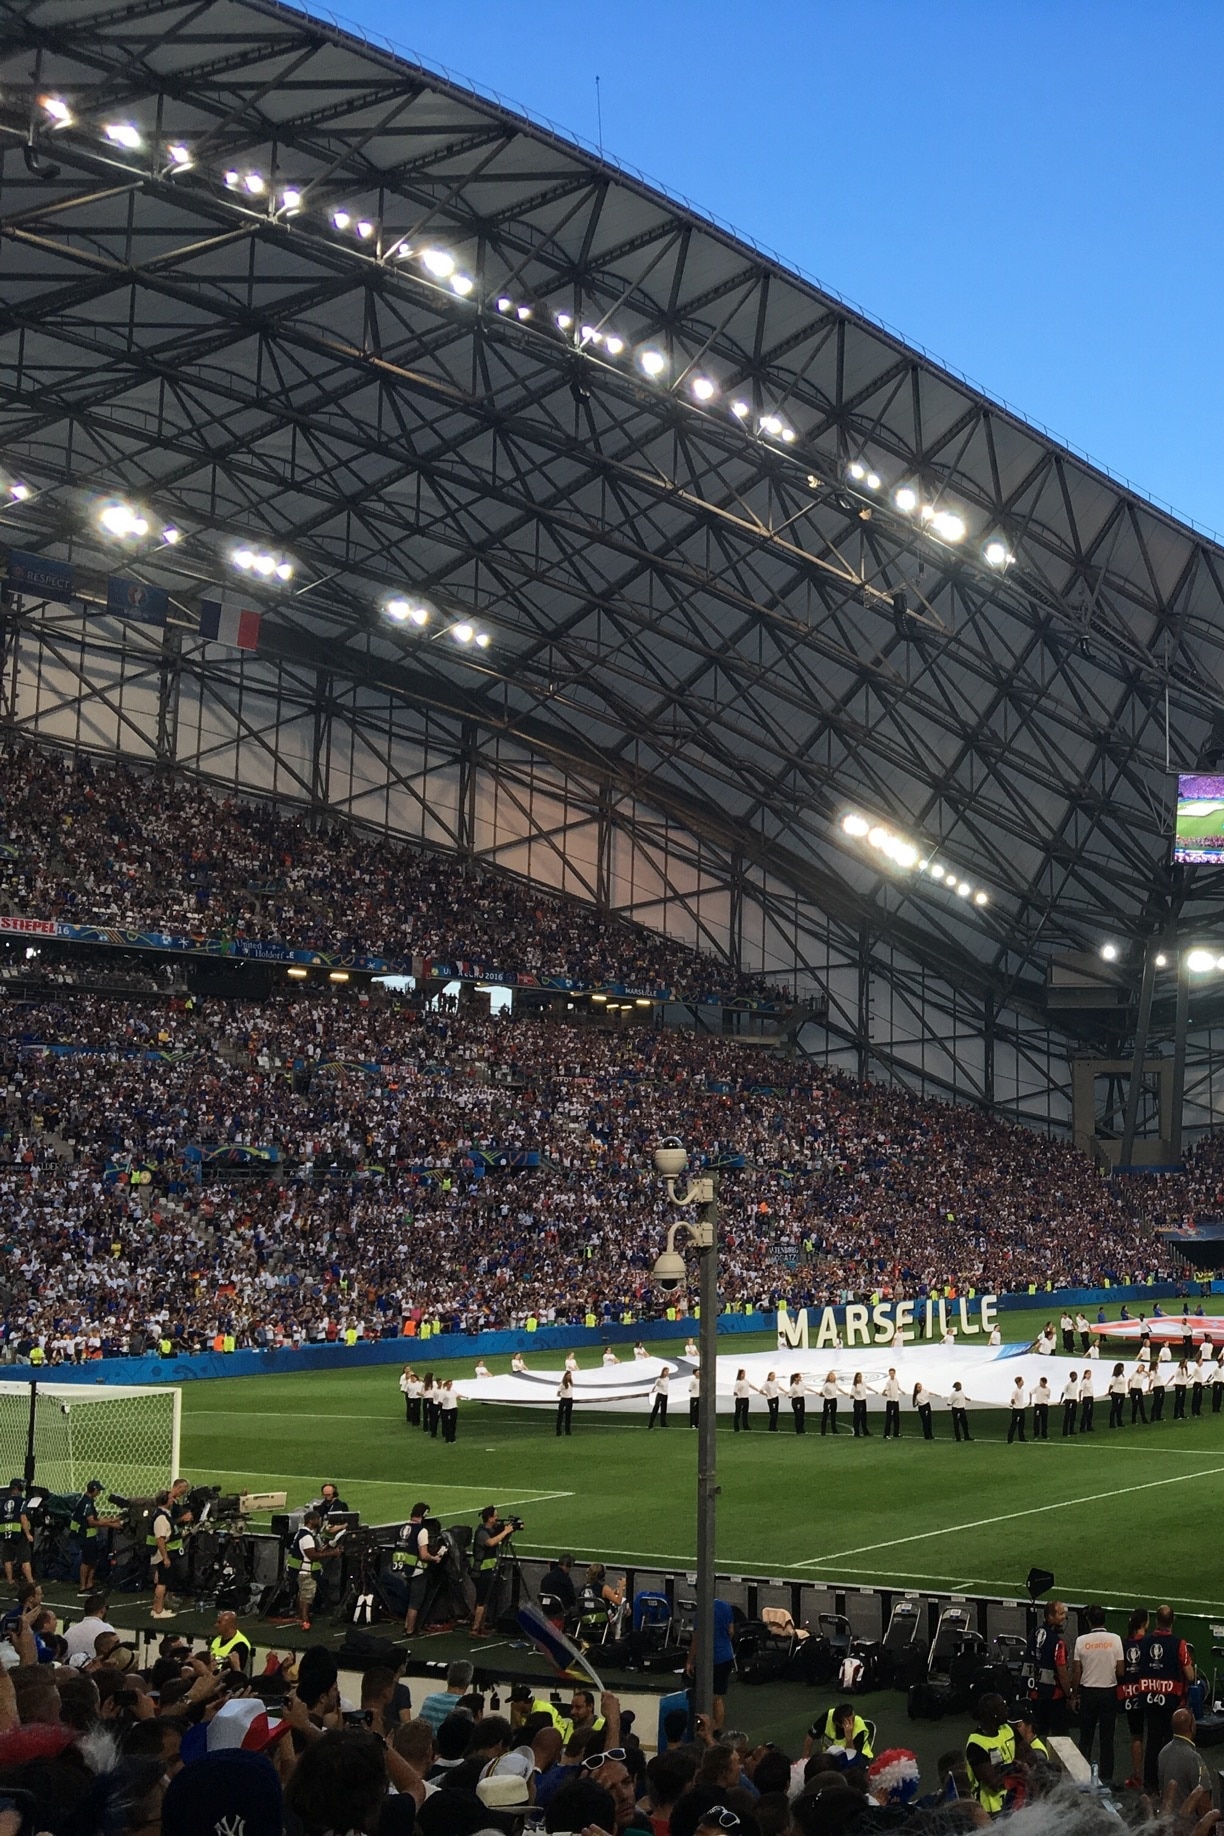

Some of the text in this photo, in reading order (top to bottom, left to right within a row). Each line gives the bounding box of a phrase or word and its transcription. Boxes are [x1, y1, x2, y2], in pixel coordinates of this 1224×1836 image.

[26, 570, 70, 590] RESPECT
[0, 918, 56, 934] STIEPEL
[485, 972, 503, 981] 2016
[777, 1295, 999, 1349] MARSEILLE
[1085, 1642, 1113, 1650] Orange
[1140, 1679, 1174, 1692] PHOTO
[1146, 1693, 1166, 1706] 640
